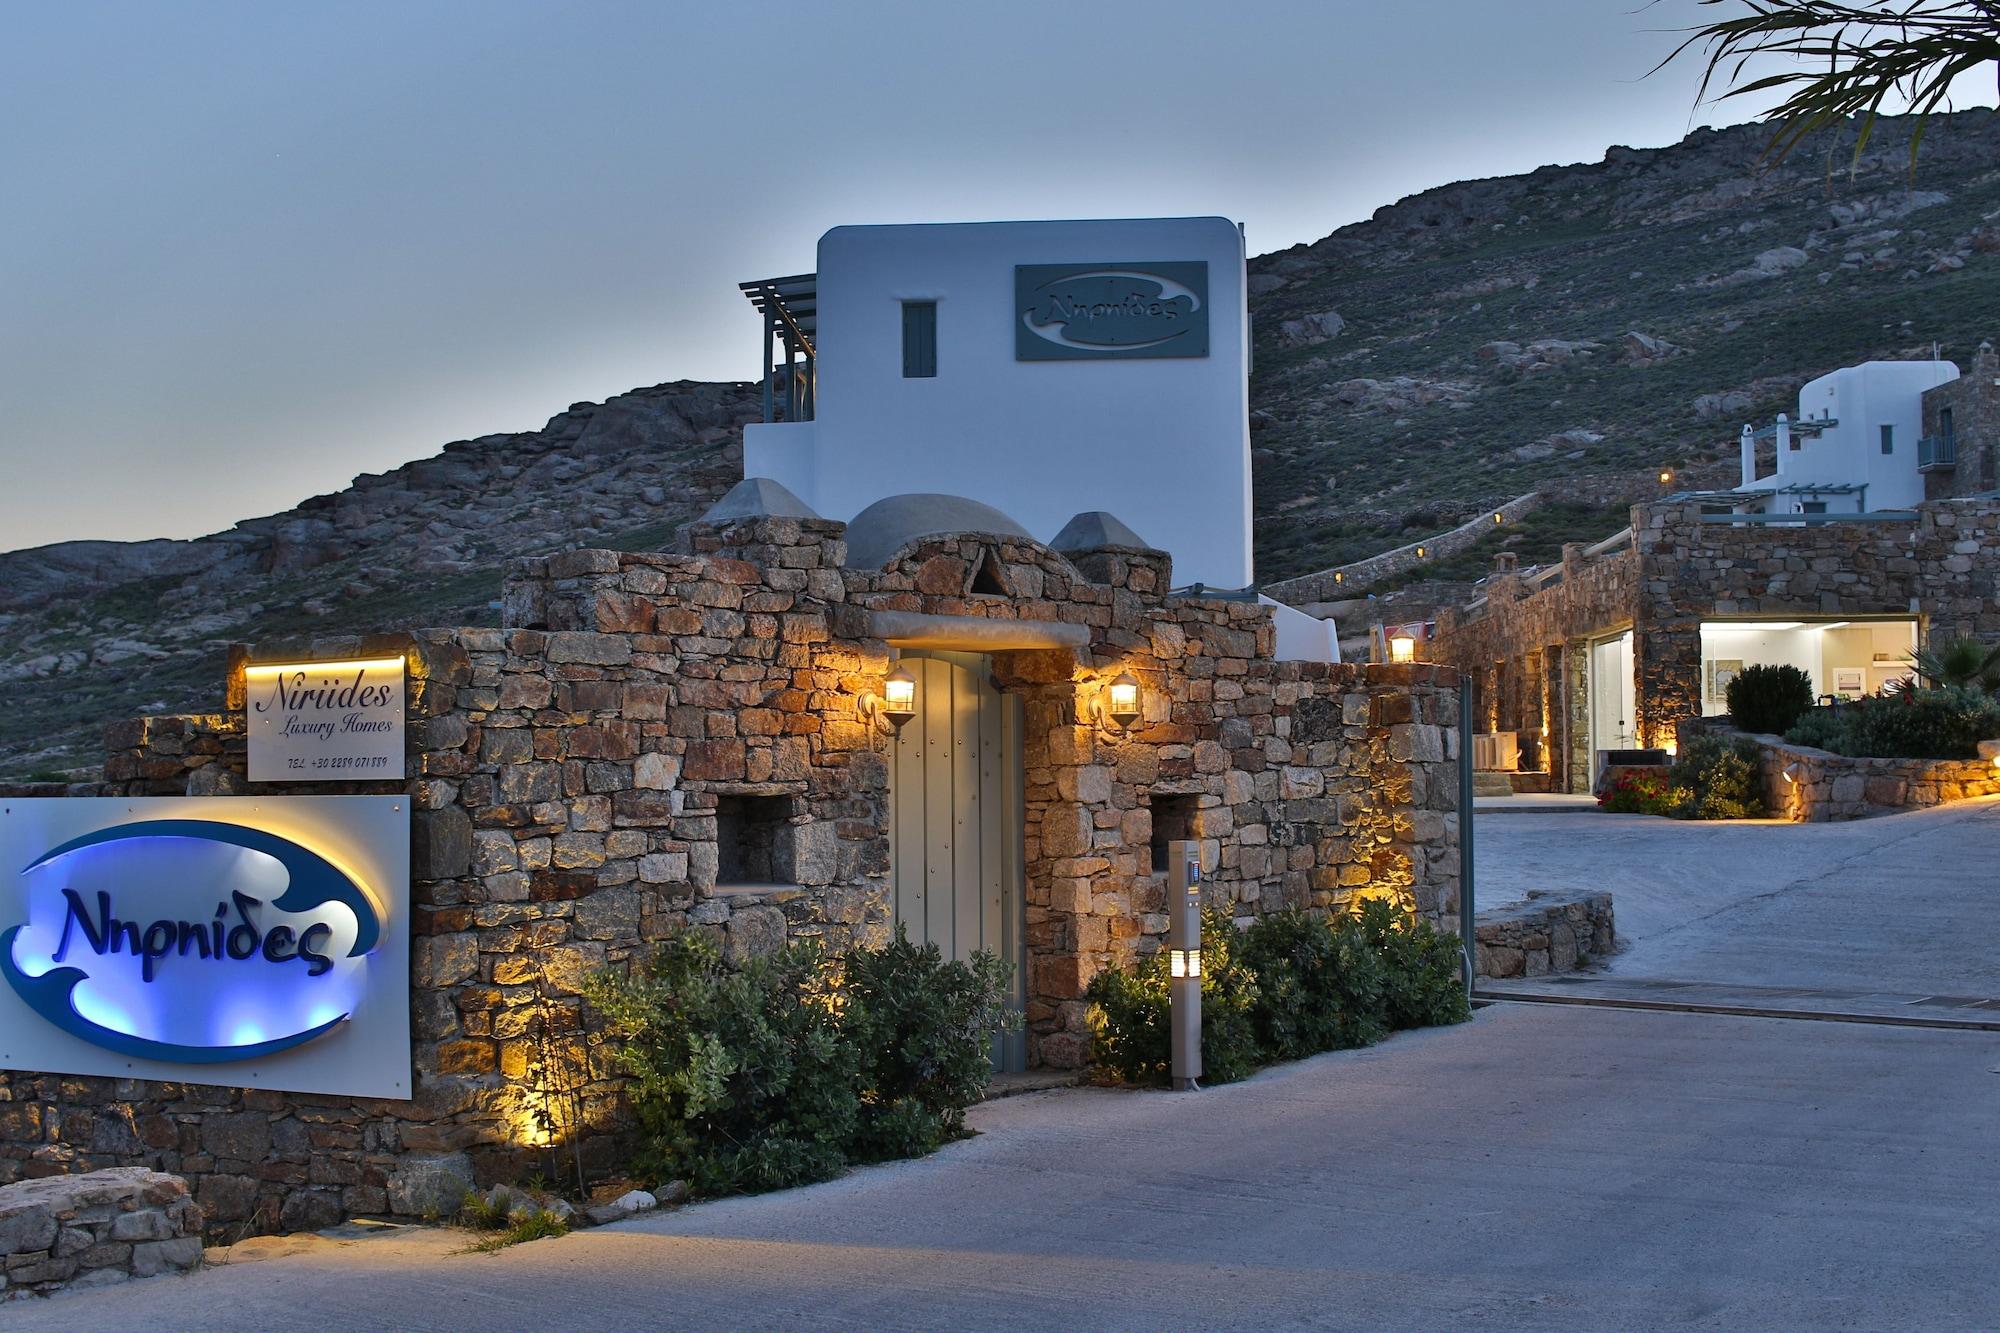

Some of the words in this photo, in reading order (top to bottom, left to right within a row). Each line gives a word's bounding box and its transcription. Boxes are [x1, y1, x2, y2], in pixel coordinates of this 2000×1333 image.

[256, 669, 394, 713] Niriides
[278, 715, 336, 741] Luxury
[339, 712, 393, 734] Homes
[52, 888, 334, 982] Νηρηίδες
